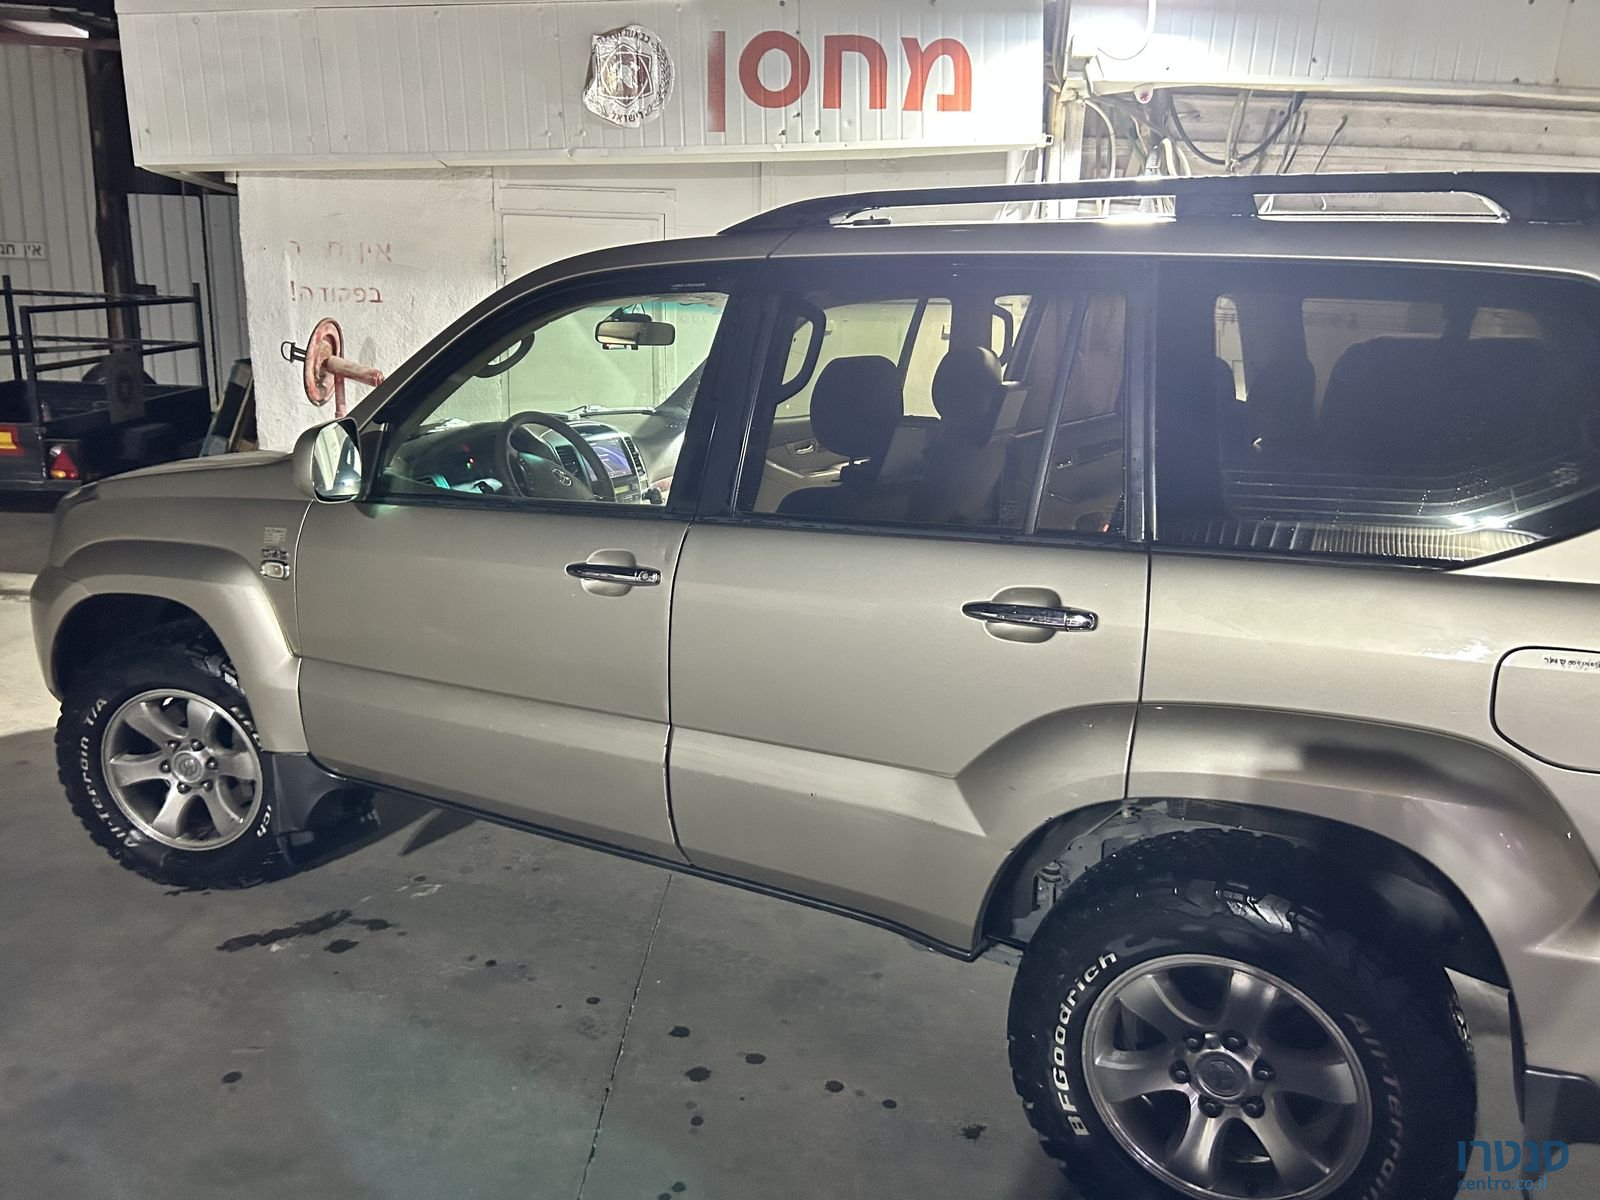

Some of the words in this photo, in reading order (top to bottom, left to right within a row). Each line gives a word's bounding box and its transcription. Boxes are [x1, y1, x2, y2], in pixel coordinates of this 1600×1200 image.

[706, 30, 972, 132] מחסן
[24, 244, 42, 257] אין
[359, 242, 392, 264] אין
[84, 698, 108, 727] T/A
[1052, 950, 1118, 1137] BFGoodrich
